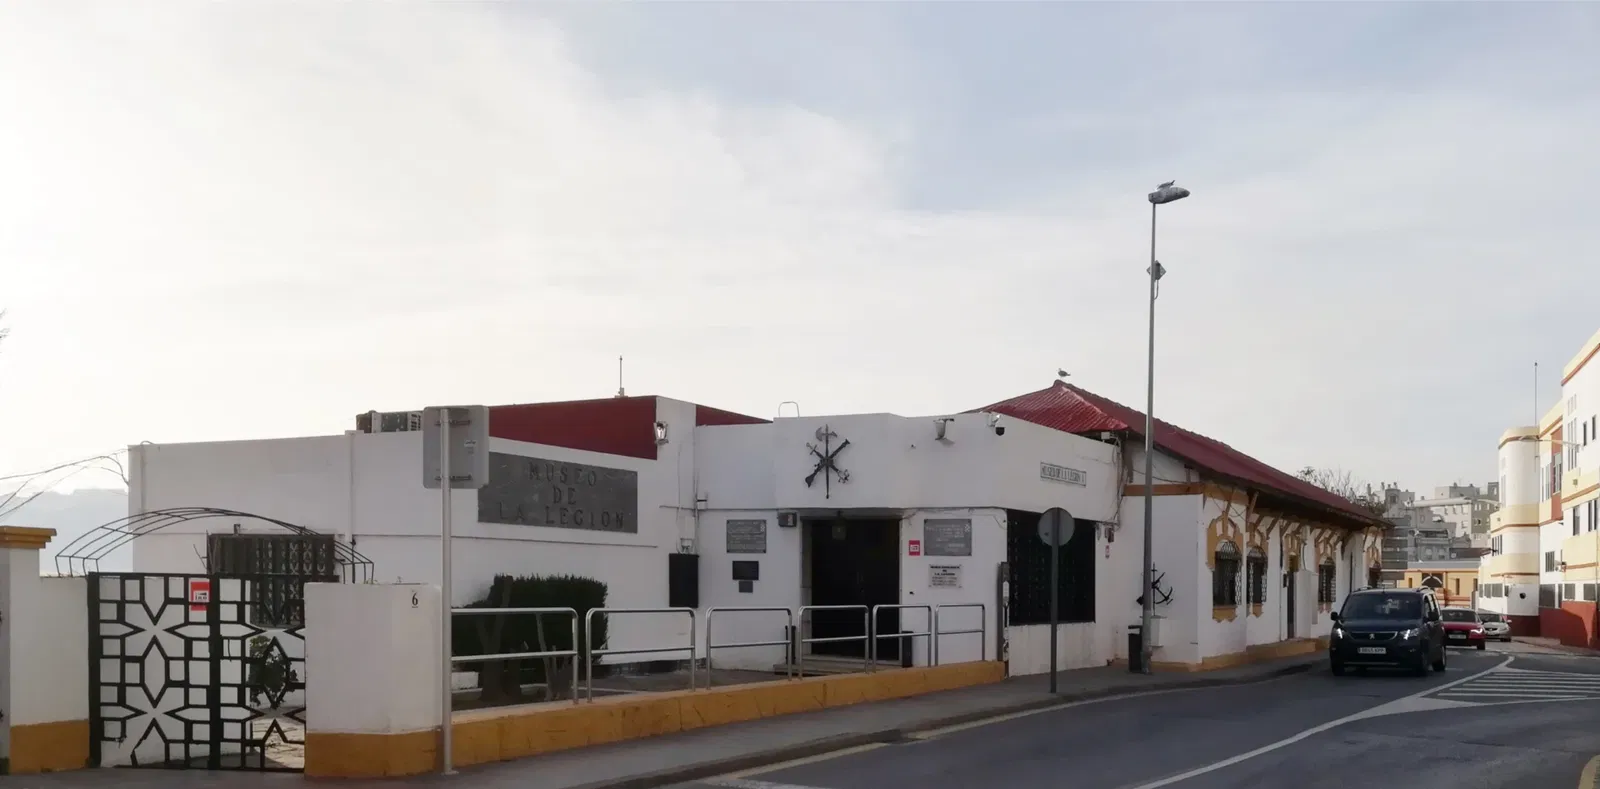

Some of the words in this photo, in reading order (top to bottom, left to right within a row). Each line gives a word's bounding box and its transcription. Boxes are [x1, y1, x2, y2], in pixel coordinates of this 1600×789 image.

[529, 461, 597, 486] MUSEO
[553, 485, 577, 505] DE
[499, 501, 526, 521] LA
[545, 506, 624, 528] LEGION
[411, 592, 419, 606] 6
